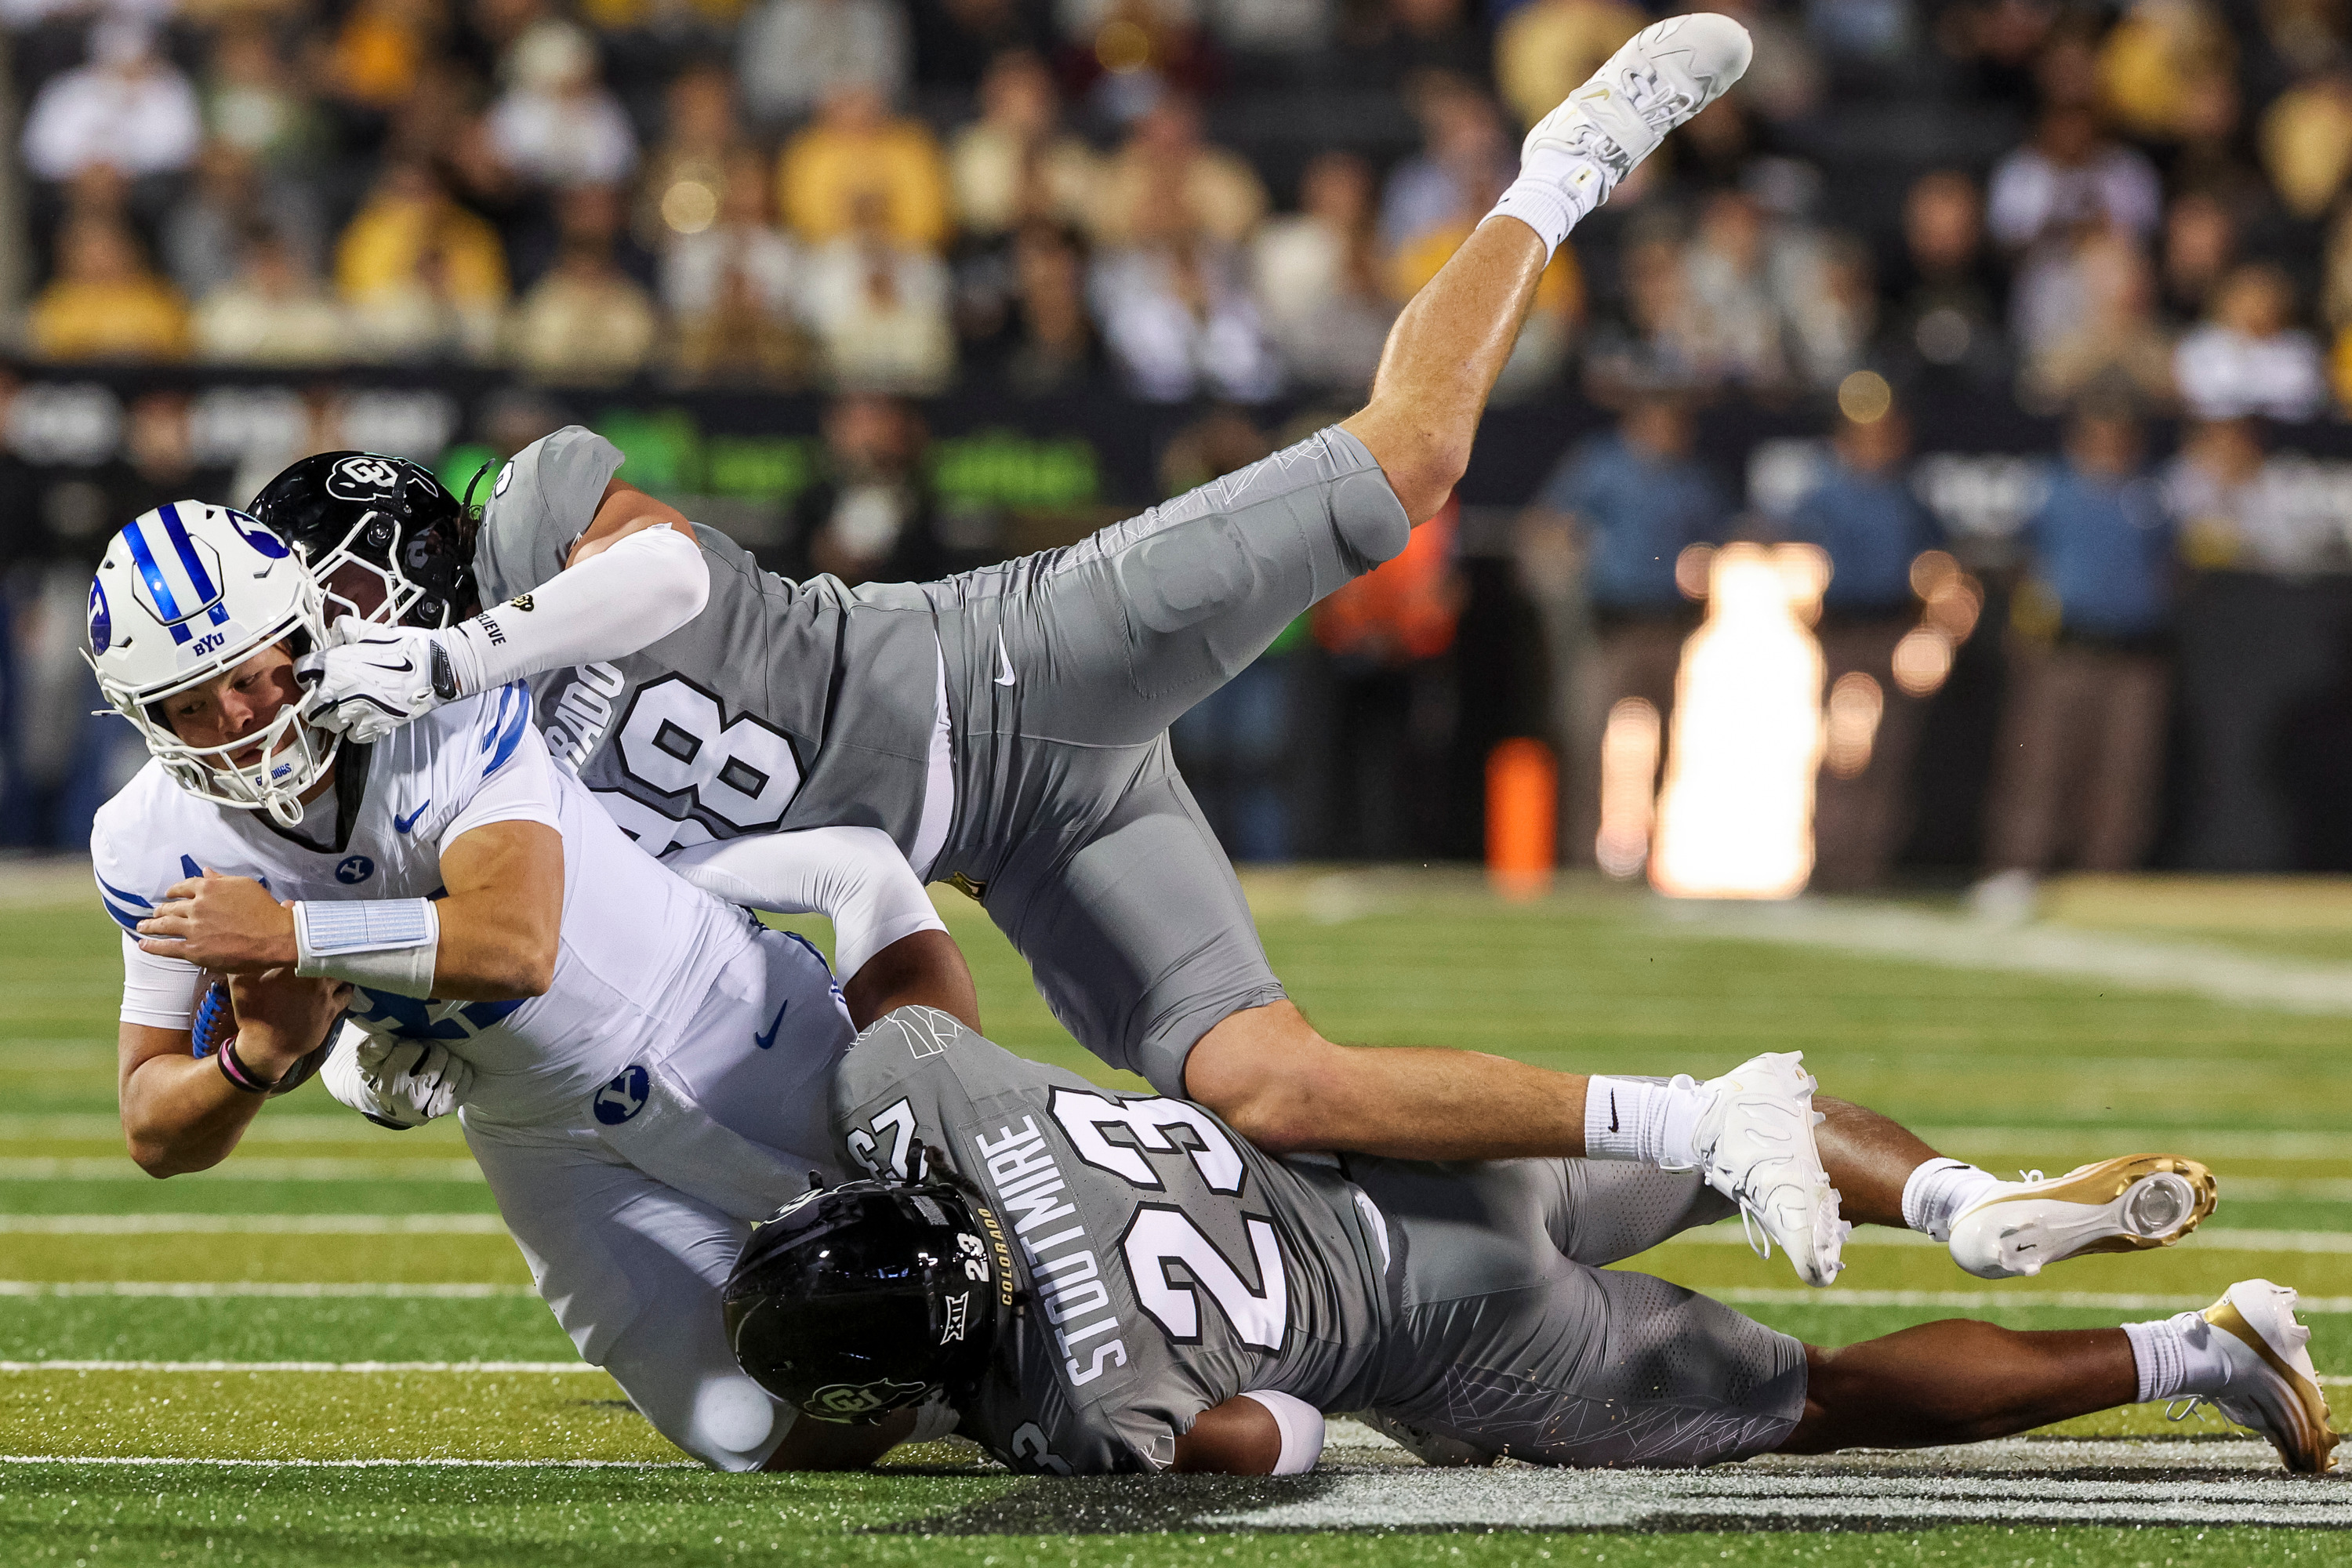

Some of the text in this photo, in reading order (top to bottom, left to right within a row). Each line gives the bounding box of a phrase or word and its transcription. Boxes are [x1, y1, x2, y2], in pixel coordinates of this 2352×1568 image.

[193, 632, 226, 657] BYU
[475, 613, 506, 647] ELIEVE
[271, 763, 292, 780] OUGS
[597, 1069, 643, 1117] Y
[1045, 1084, 1288, 1359] 23
[956, 1232, 990, 1283] 23
[976, 1114, 1127, 1388] STOUTMIRE
[978, 1207, 1013, 1307] COLORADO
